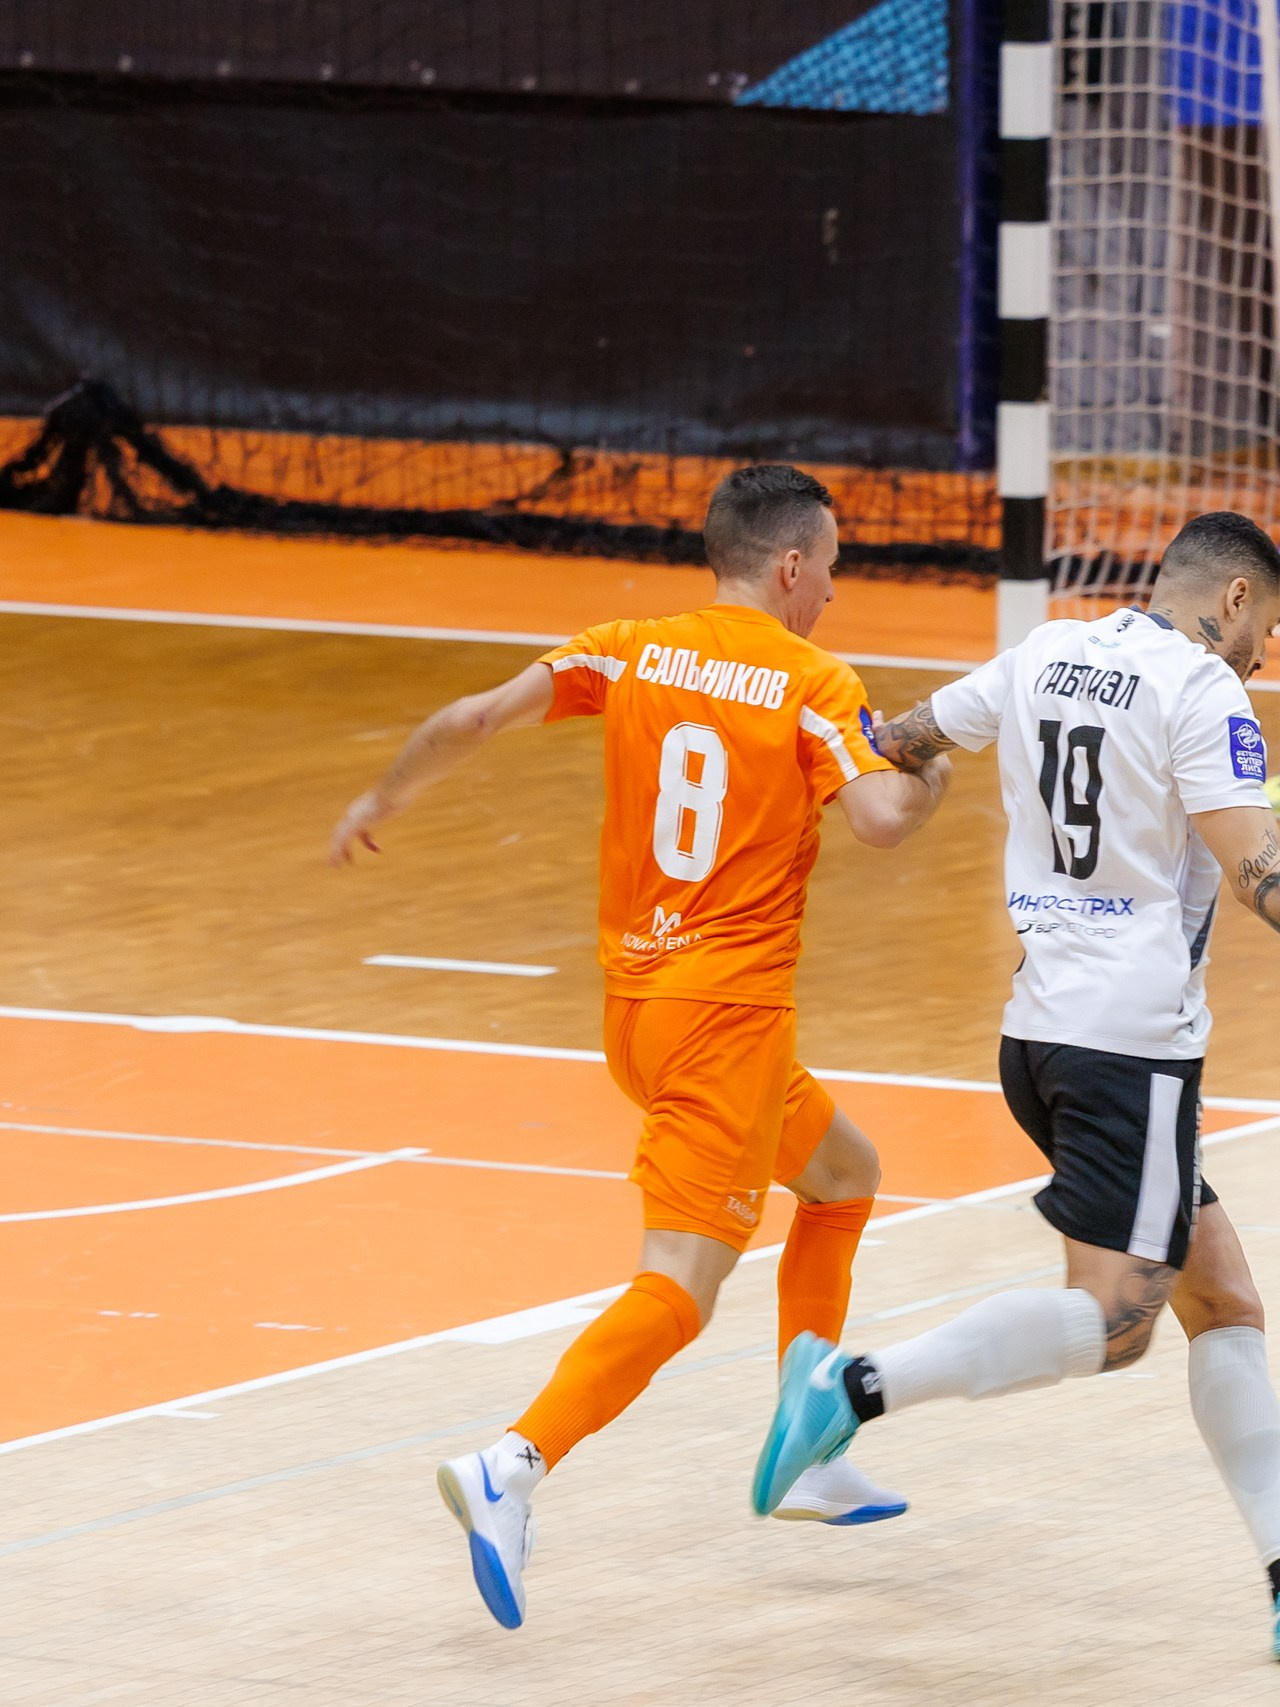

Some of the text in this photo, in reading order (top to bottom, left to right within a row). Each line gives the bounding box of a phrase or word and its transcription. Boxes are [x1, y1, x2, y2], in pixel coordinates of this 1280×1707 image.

[636, 643, 790, 710] САЛЬНИКОВ
[653, 722, 728, 882] 8
[1038, 719, 1105, 880] 19
